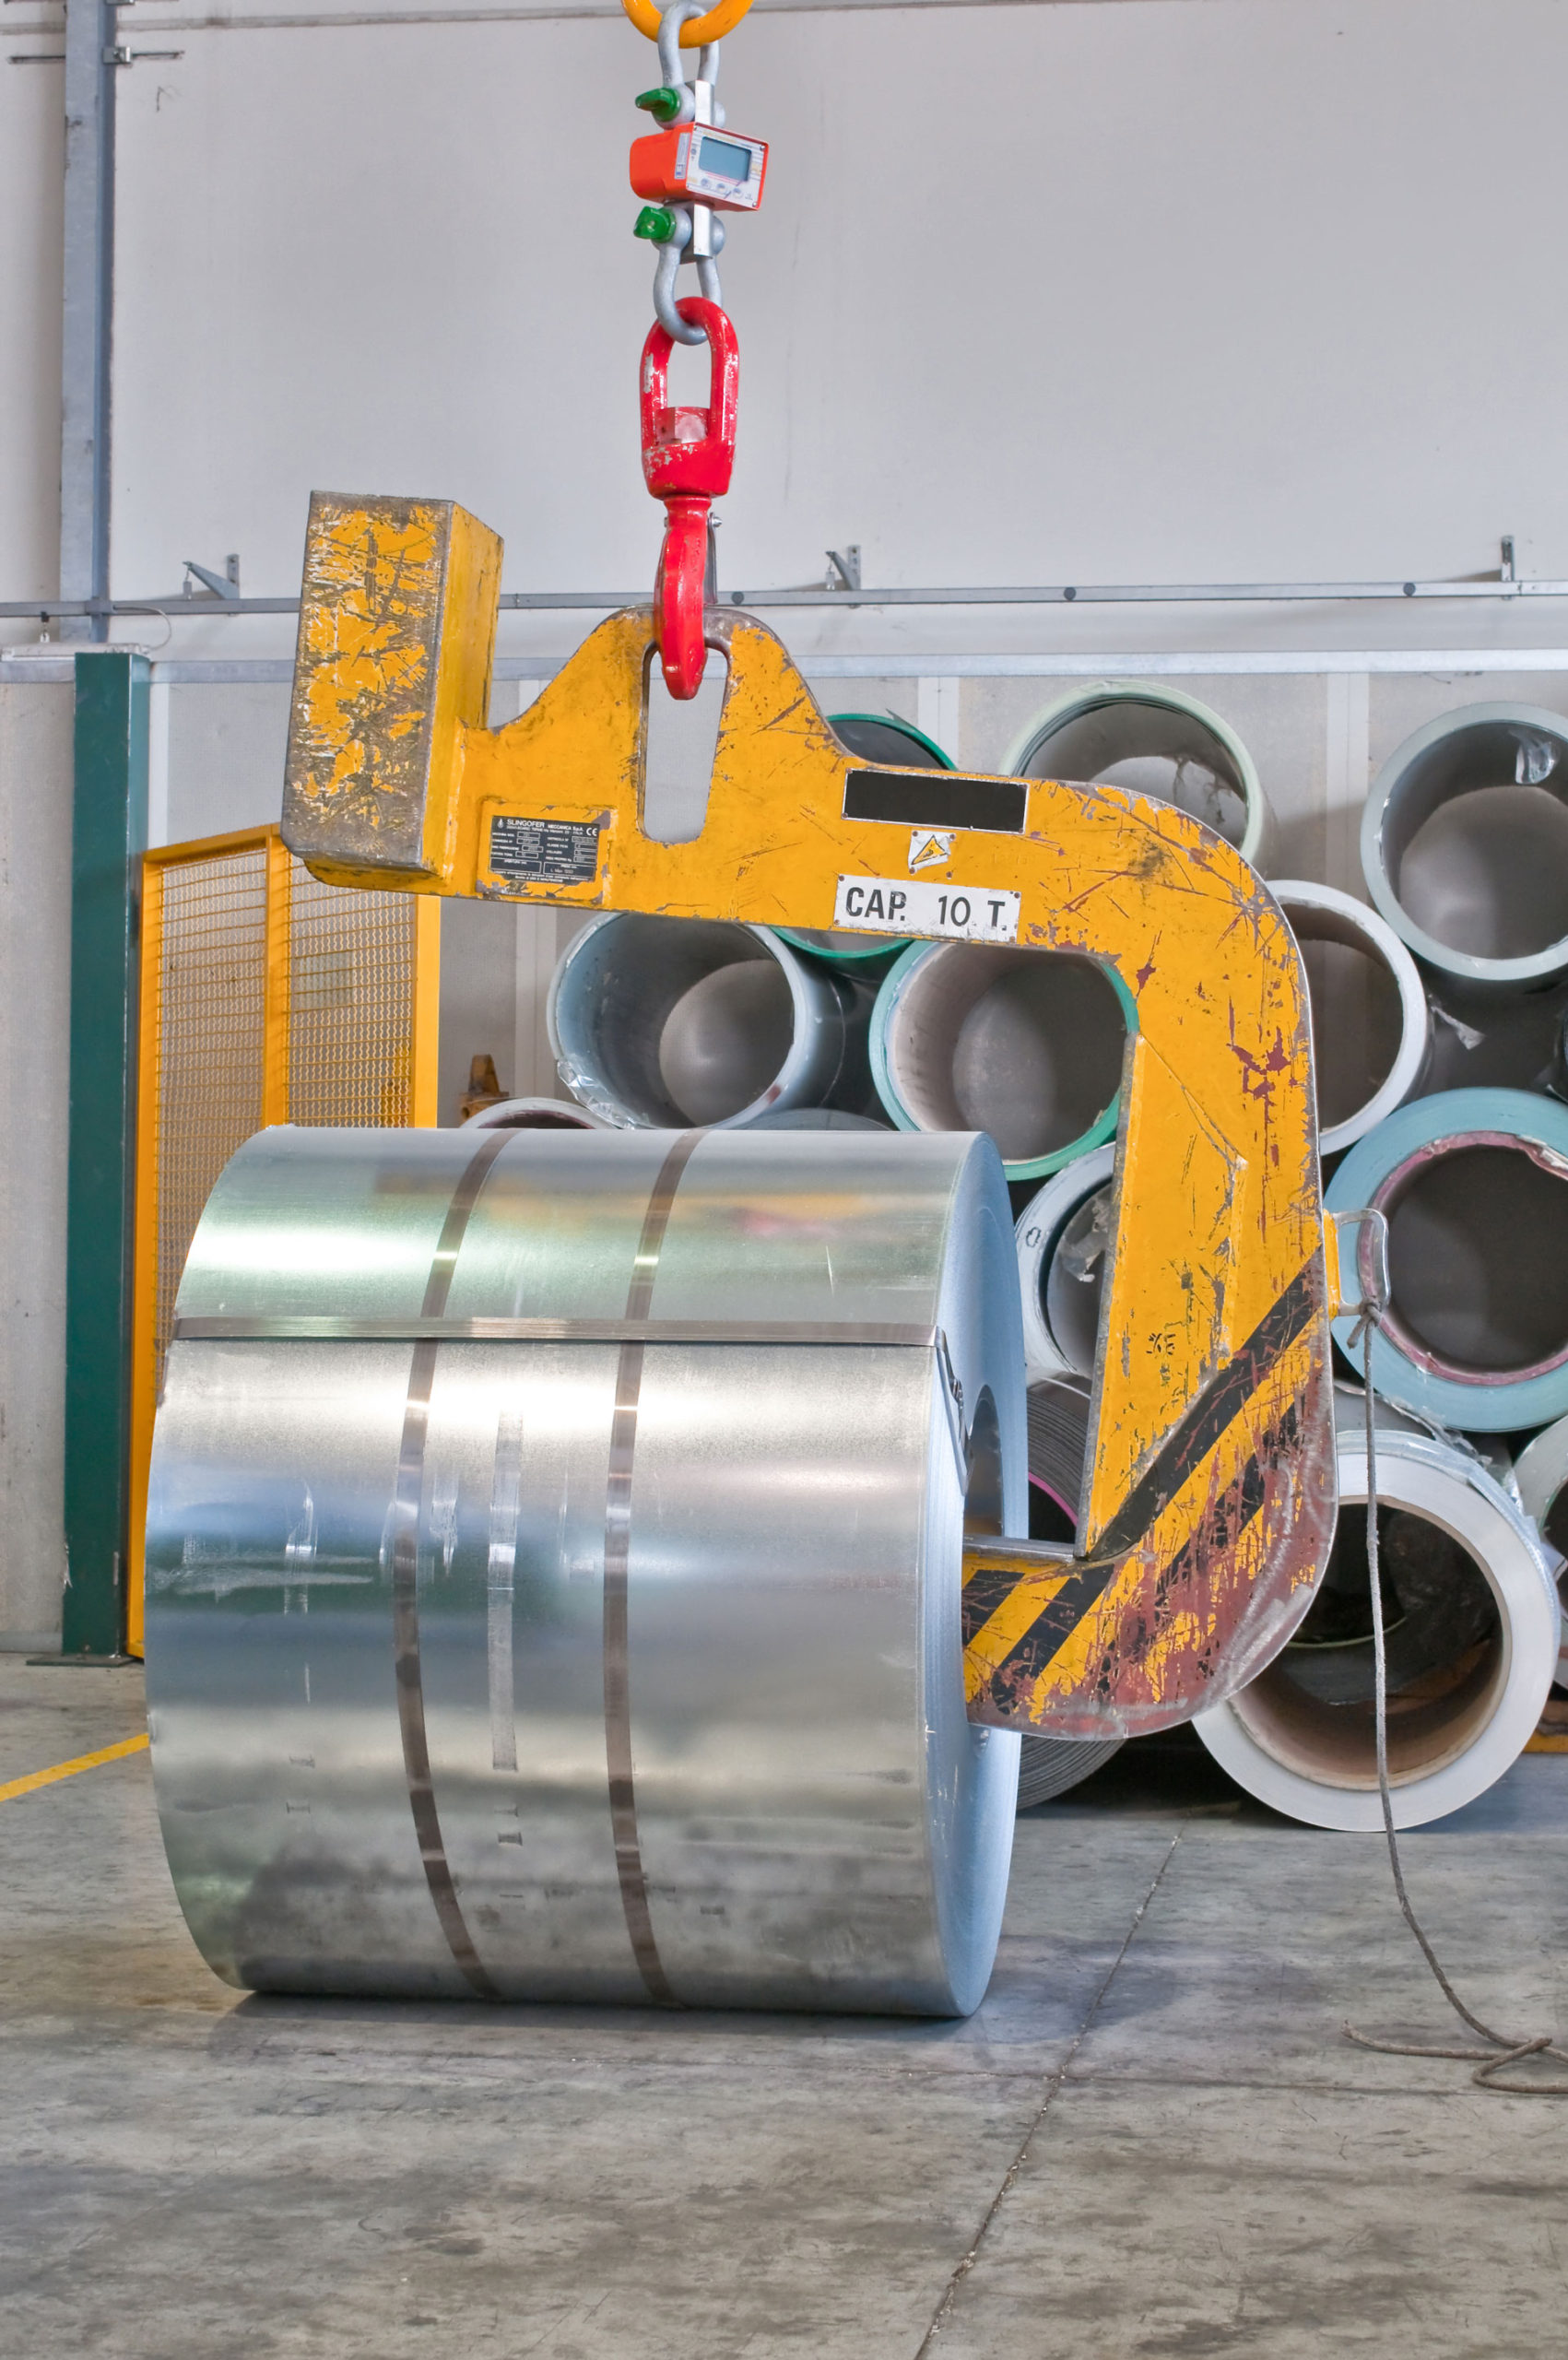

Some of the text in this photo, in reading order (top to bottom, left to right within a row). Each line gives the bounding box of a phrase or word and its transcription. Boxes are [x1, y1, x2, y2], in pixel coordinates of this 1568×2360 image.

[507, 819, 545, 828] SLINGOFER
[846, 887, 1008, 931] CAP. 10 T.
